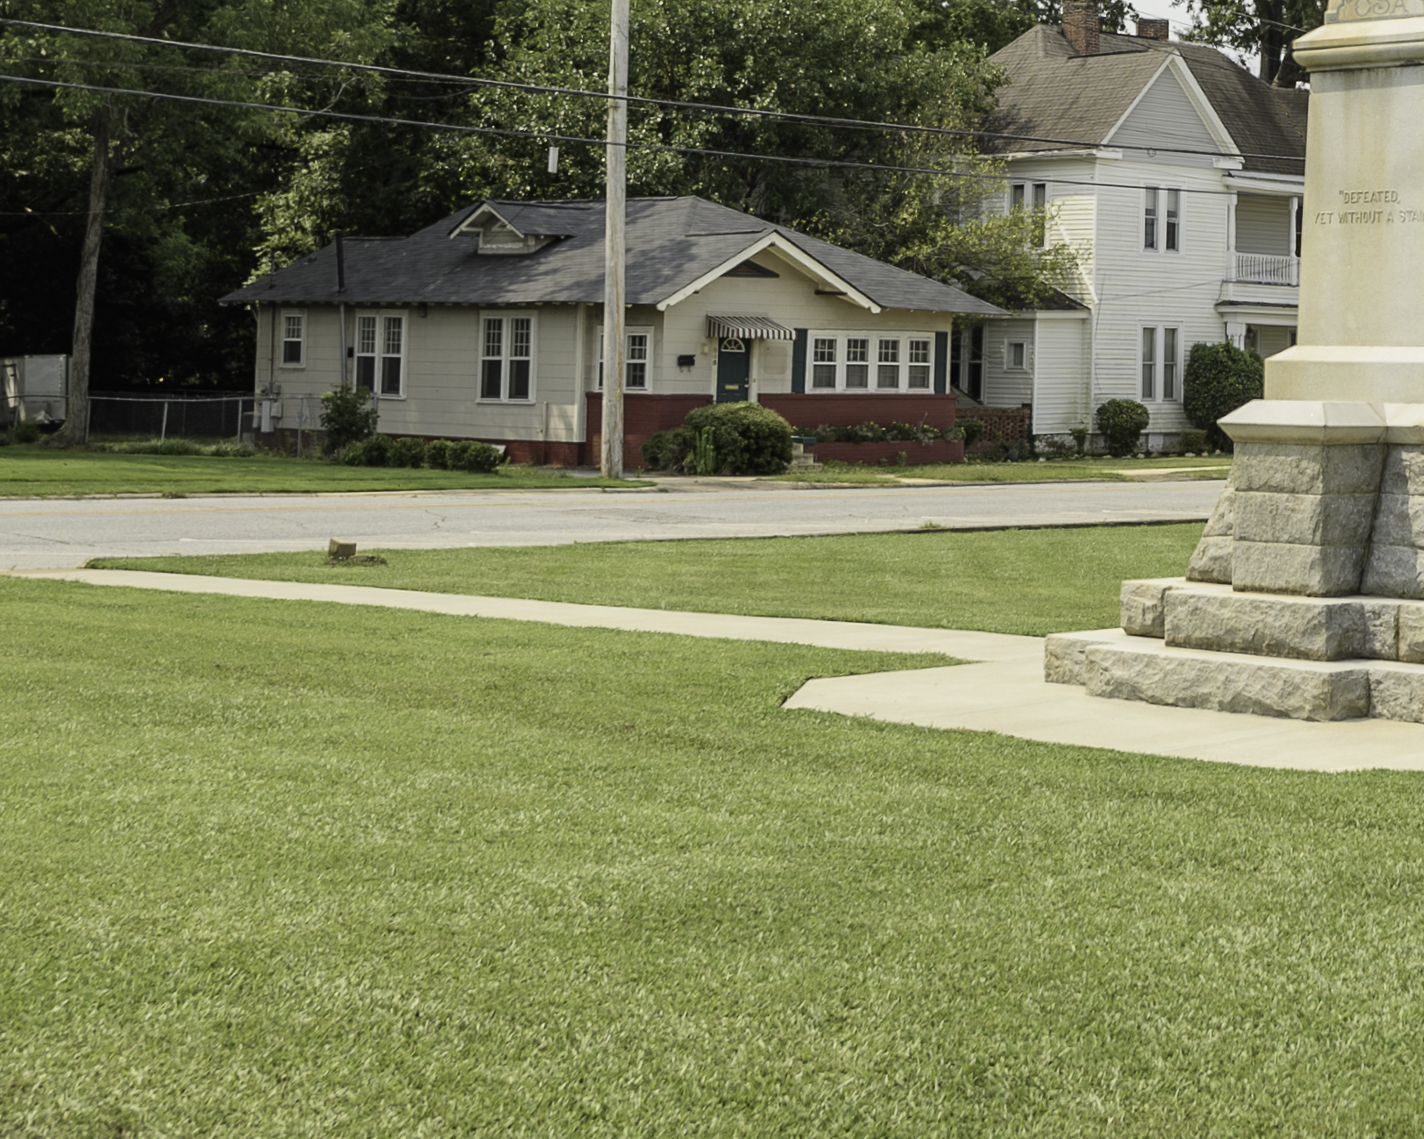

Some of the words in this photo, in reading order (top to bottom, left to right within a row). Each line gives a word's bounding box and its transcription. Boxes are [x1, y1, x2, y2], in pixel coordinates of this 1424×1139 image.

[1314, 211, 1334, 225] YET
[1338, 210, 1384, 224] WITHOUT
[1386, 210, 1395, 224] A
